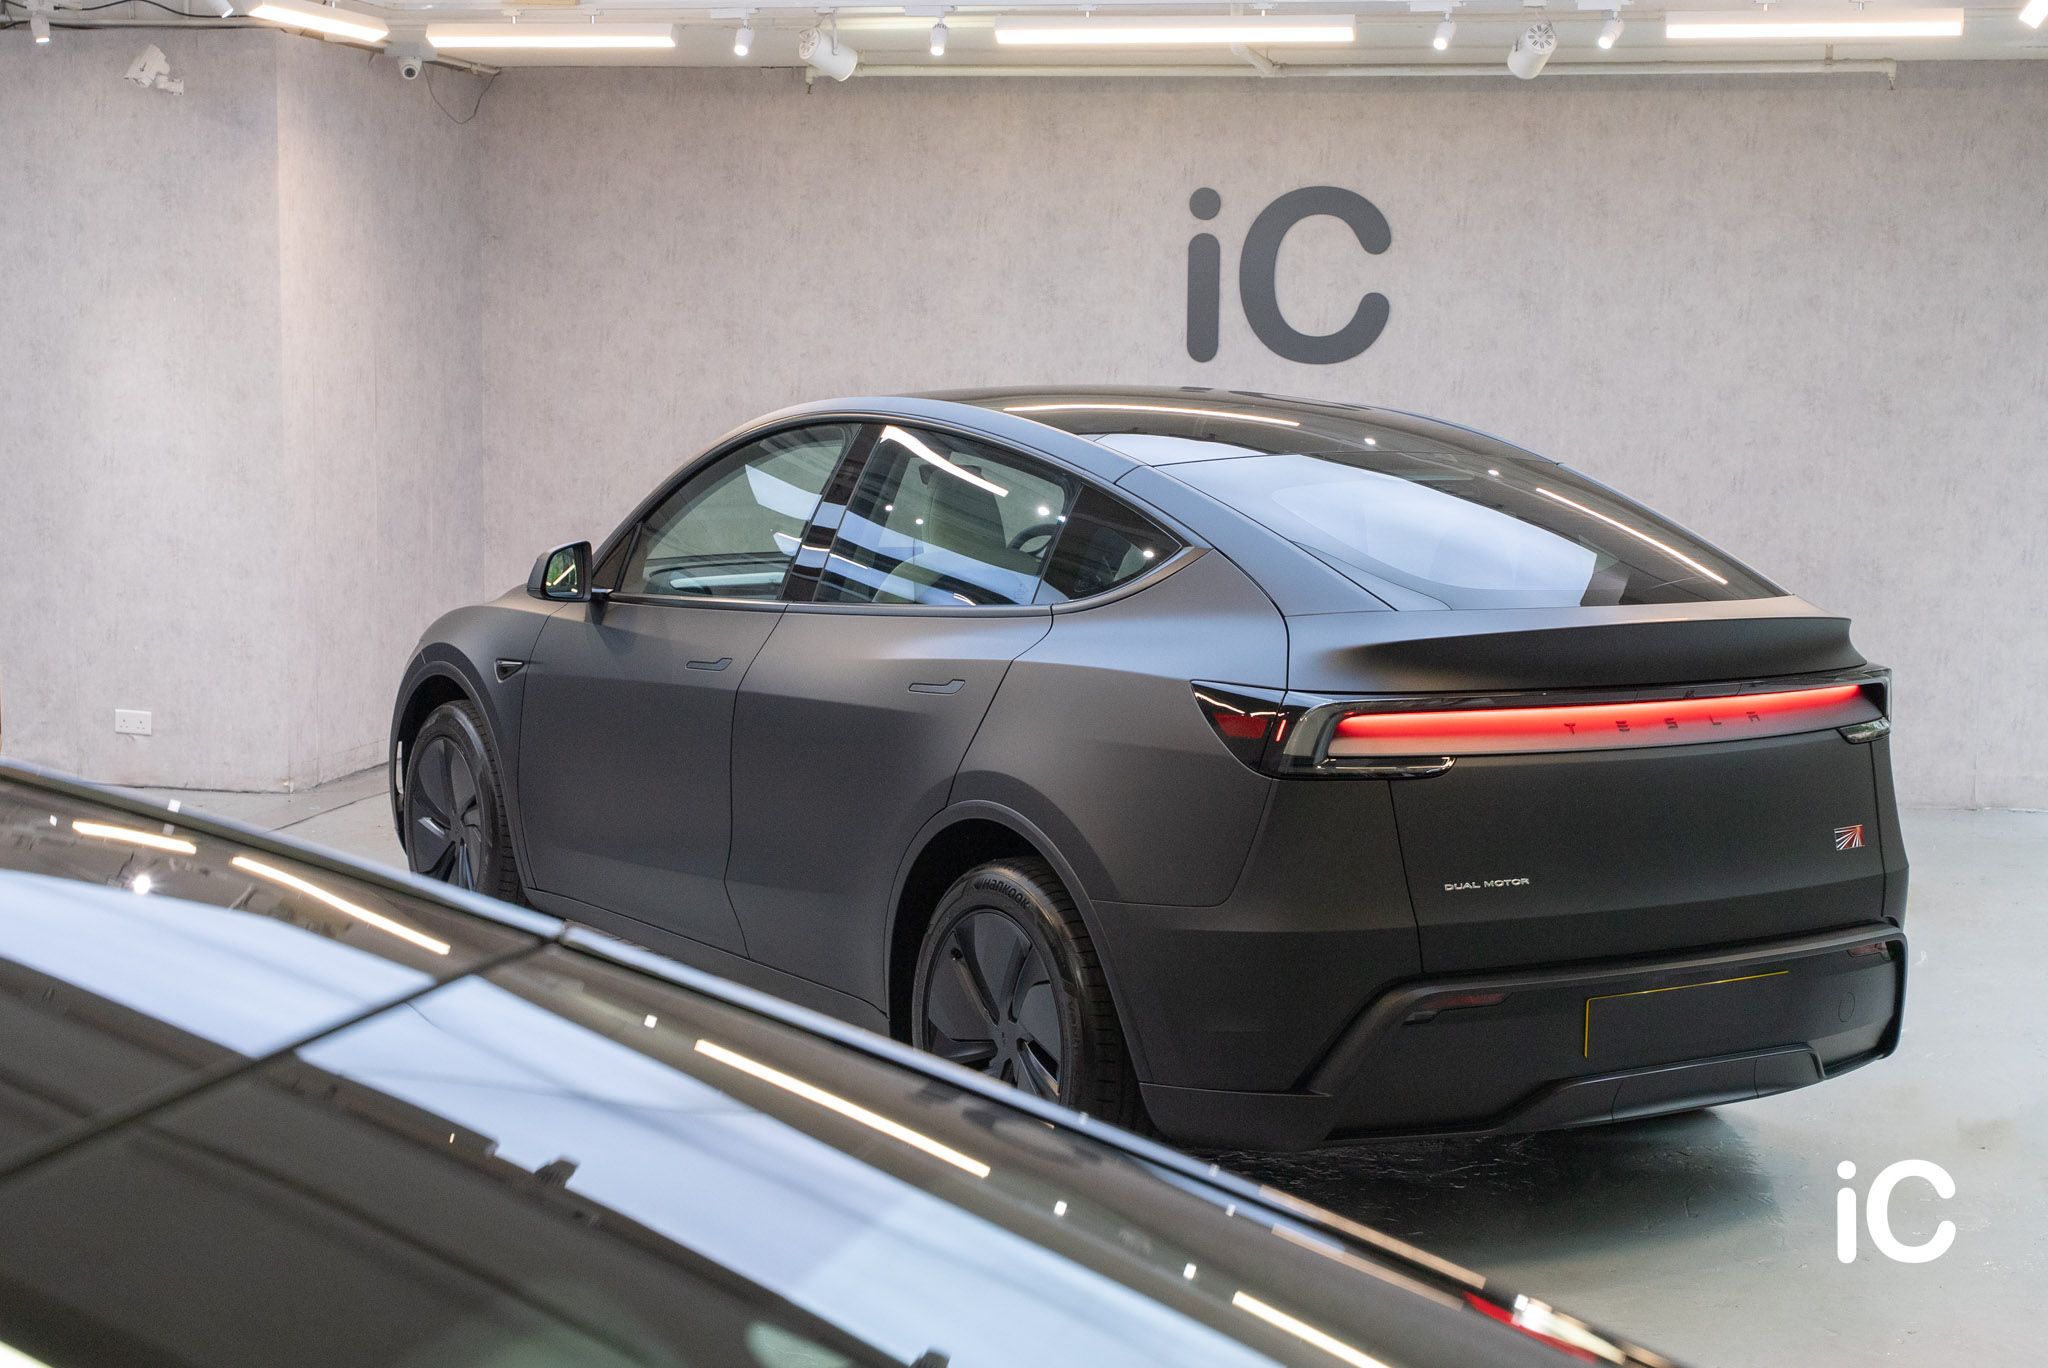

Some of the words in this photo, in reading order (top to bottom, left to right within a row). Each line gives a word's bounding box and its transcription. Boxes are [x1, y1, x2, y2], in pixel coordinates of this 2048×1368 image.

[1187, 186, 1391, 364] iC
[1564, 711, 1760, 735] TESLA
[1444, 882, 1481, 891] DUAL
[1483, 878, 1530, 888] MOTOR
